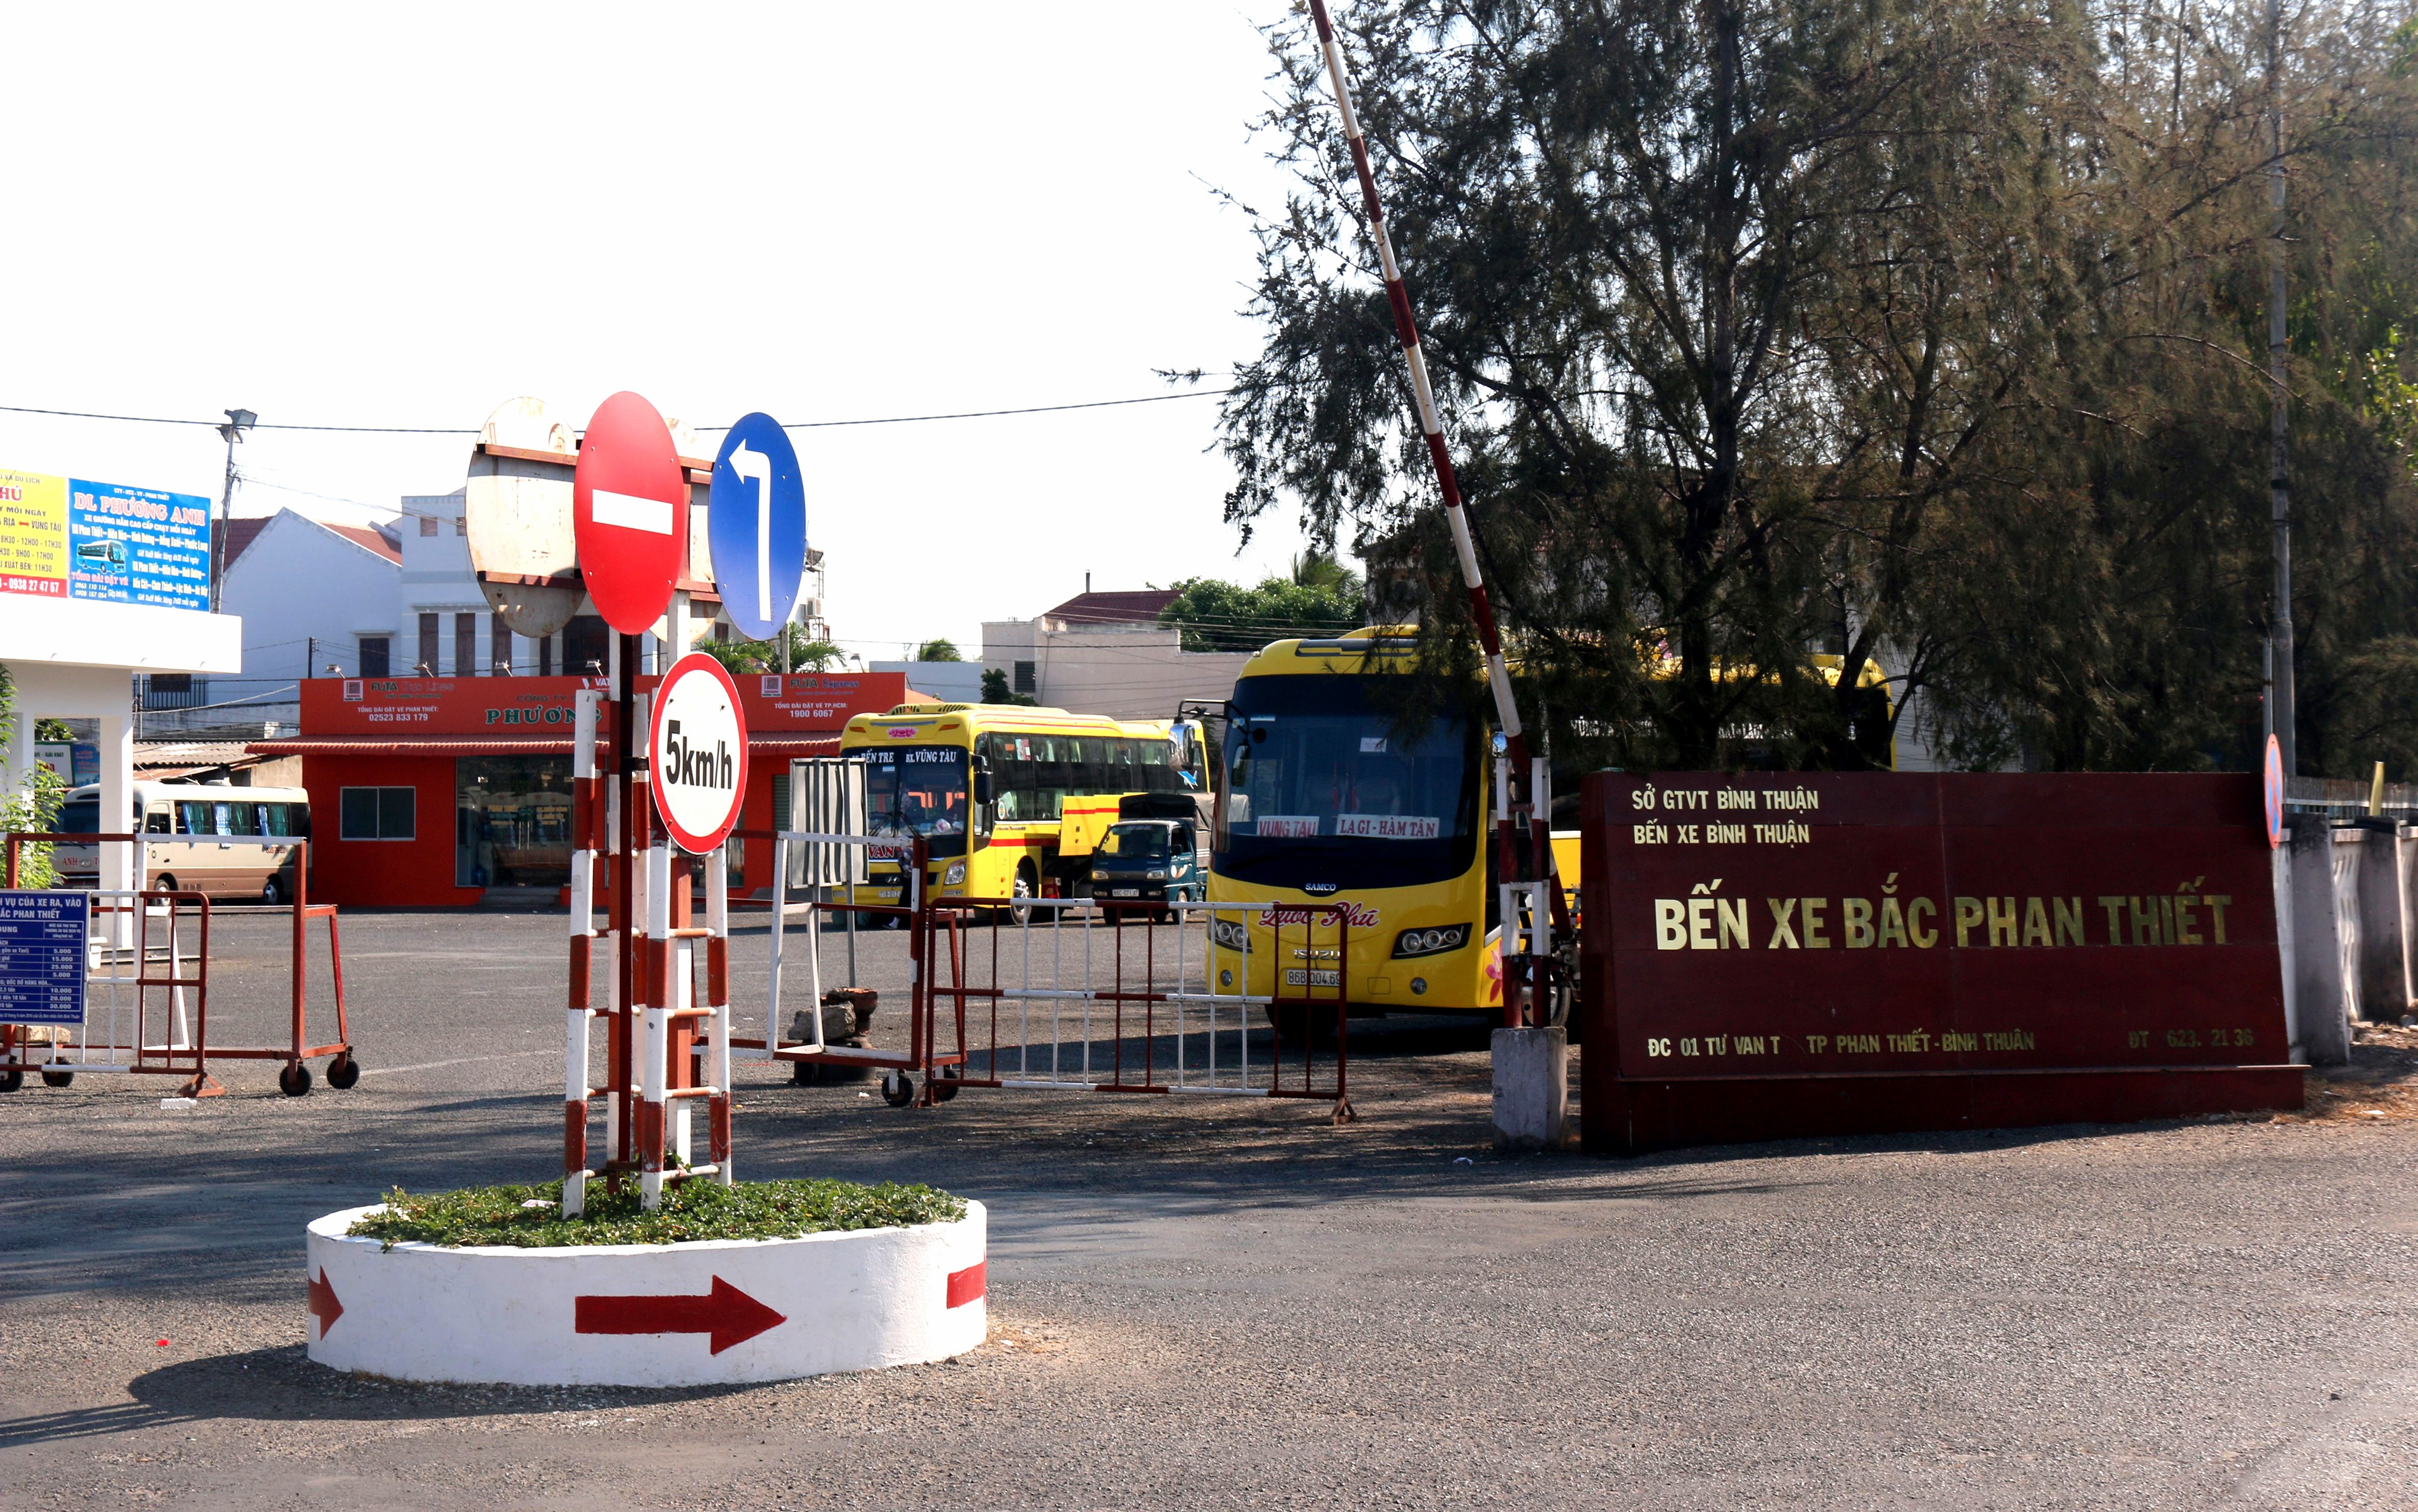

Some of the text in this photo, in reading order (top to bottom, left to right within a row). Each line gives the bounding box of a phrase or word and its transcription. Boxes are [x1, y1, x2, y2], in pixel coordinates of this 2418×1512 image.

[74, 492, 205, 526] DL PHƯƠNG ANH
[129, 520, 141, 528] CAO
[21, 538, 38, 546] 12H00
[45, 540, 61, 549] 17H30
[16, 549, 30, 558] 9H00
[37, 552, 53, 560] 17H00
[9, 578, 27, 590] 0938
[28, 580, 38, 591] 27
[40, 581, 48, 592] 47
[50, 582, 59, 593] 67
[371, 680, 454, 692] FUTA Bus Lines
[789, 678, 860, 689] FUTA Express
[517, 693, 549, 702] CÔNG
[358, 705, 372, 713] TỔNG
[485, 705, 602, 724] PHƯƠN
[813, 709, 834, 718] 6067
[414, 713, 428, 721] 179
[666, 719, 732, 790] 5km/h
[878, 752, 894, 763] TRE
[939, 748, 957, 762] TÀU
[1632, 783, 1818, 814] SỞ GTVT BÌNH THUẬN
[1379, 817, 1407, 836] HÀM
[1410, 818, 1436, 837] TÂN
[1634, 819, 1809, 849] BẾN XE BÌNH THUẬN
[868, 845, 895, 859] VAN
[63, 857, 78, 866] ANH
[1305, 883, 1337, 891] SAMCO
[5, 898, 15, 908] VỤ
[18, 895, 35, 906] CỦA
[37, 898, 48, 906] XE
[50, 898, 63, 908] RA,
[65, 896, 81, 907] VÀO
[13, 910, 35, 918] PHAN
[37, 907, 60, 919] THIẾT
[1655, 872, 2232, 950] BẾN XE BẮC PHAN THIẾT
[1293, 948, 1341, 960] ISUZU
[1648, 1038, 1671, 1057] ĐC
[1680, 1038, 1700, 1056] 01
[1734, 1036, 1765, 1055] VAN
[1806, 1035, 1828, 1053] TP
[1836, 1034, 1880, 1053] PHAN
